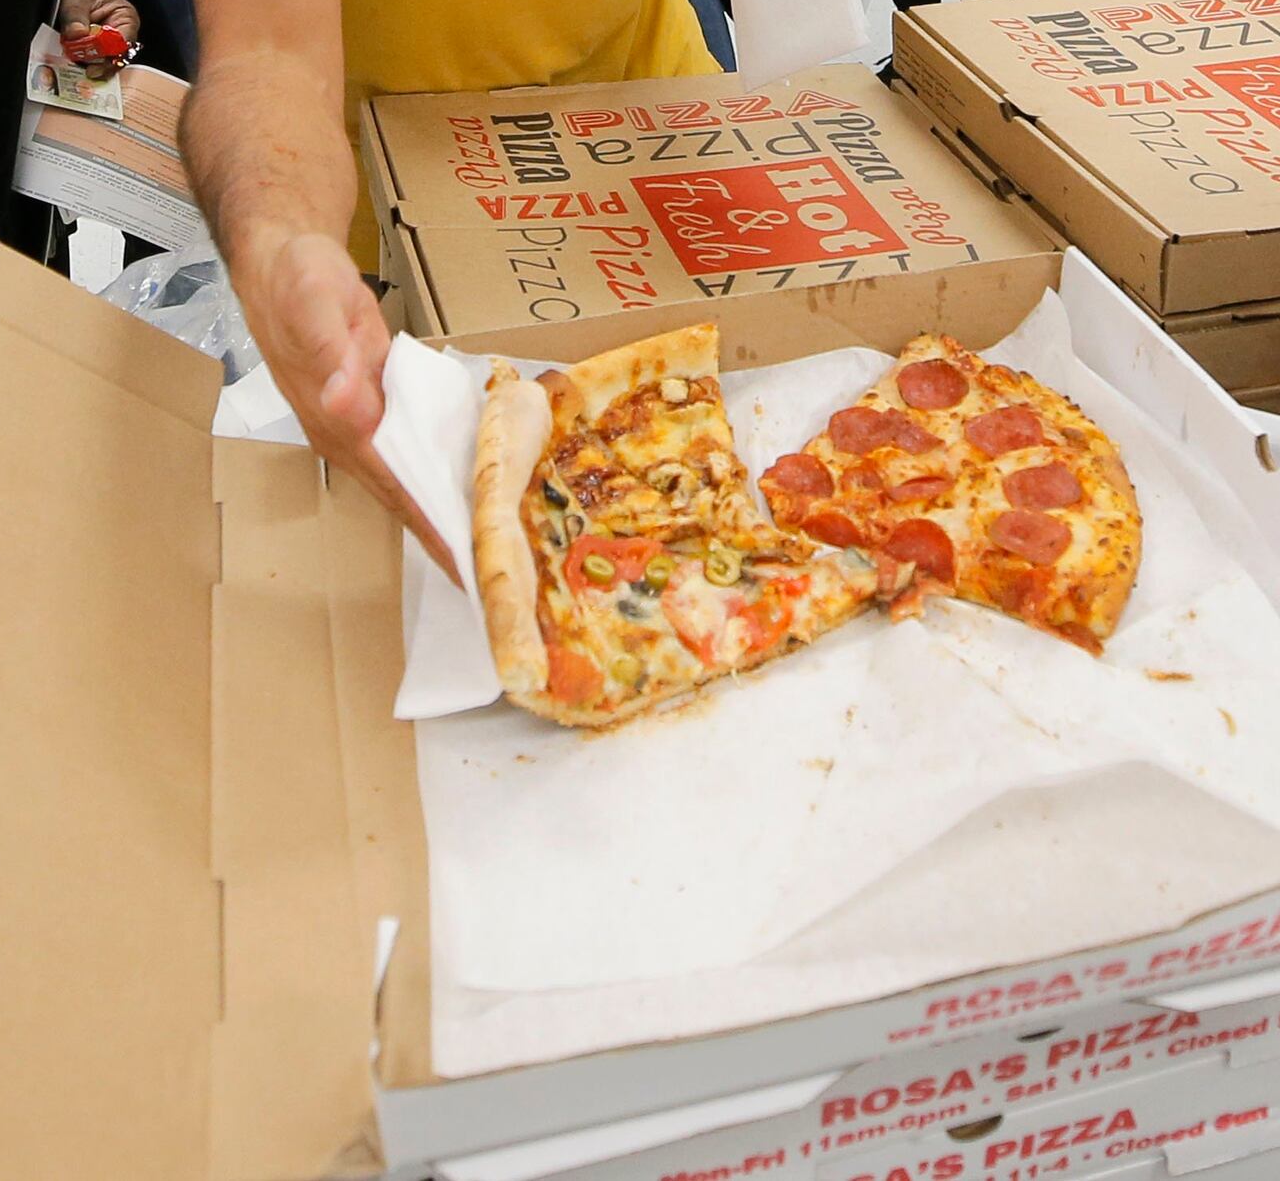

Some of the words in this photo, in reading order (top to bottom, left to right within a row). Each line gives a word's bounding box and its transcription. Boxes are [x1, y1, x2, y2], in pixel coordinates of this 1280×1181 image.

[1028, 11, 1139, 74] Pizza
[561, 89, 859, 137] PIZZA
[1066, 78, 1214, 108] PIZZA
[489, 115, 573, 185] Pizza
[814, 112, 905, 185] Pizza
[1108, 111, 1244, 194] Pizza
[477, 192, 630, 221] PIZZA
[655, 176, 772, 268] Fresh
[726, 207, 789, 235] &
[765, 161, 888, 254] Hot
[925, 960, 1128, 1018] ROSA'S
[821, 1054, 1028, 1127] ROSA'S
[1046, 1009, 1200, 1069] PIZZA
[1006, 1071, 1056, 1103] Sat
[1070, 1055, 1133, 1084] 11-4
[1167, 1018, 1270, 1058] Closed
[984, 1108, 1138, 1169] PIZZA
[1105, 1122, 1206, 1159] Closed
[1214, 1106, 1270, 1132] Sun
